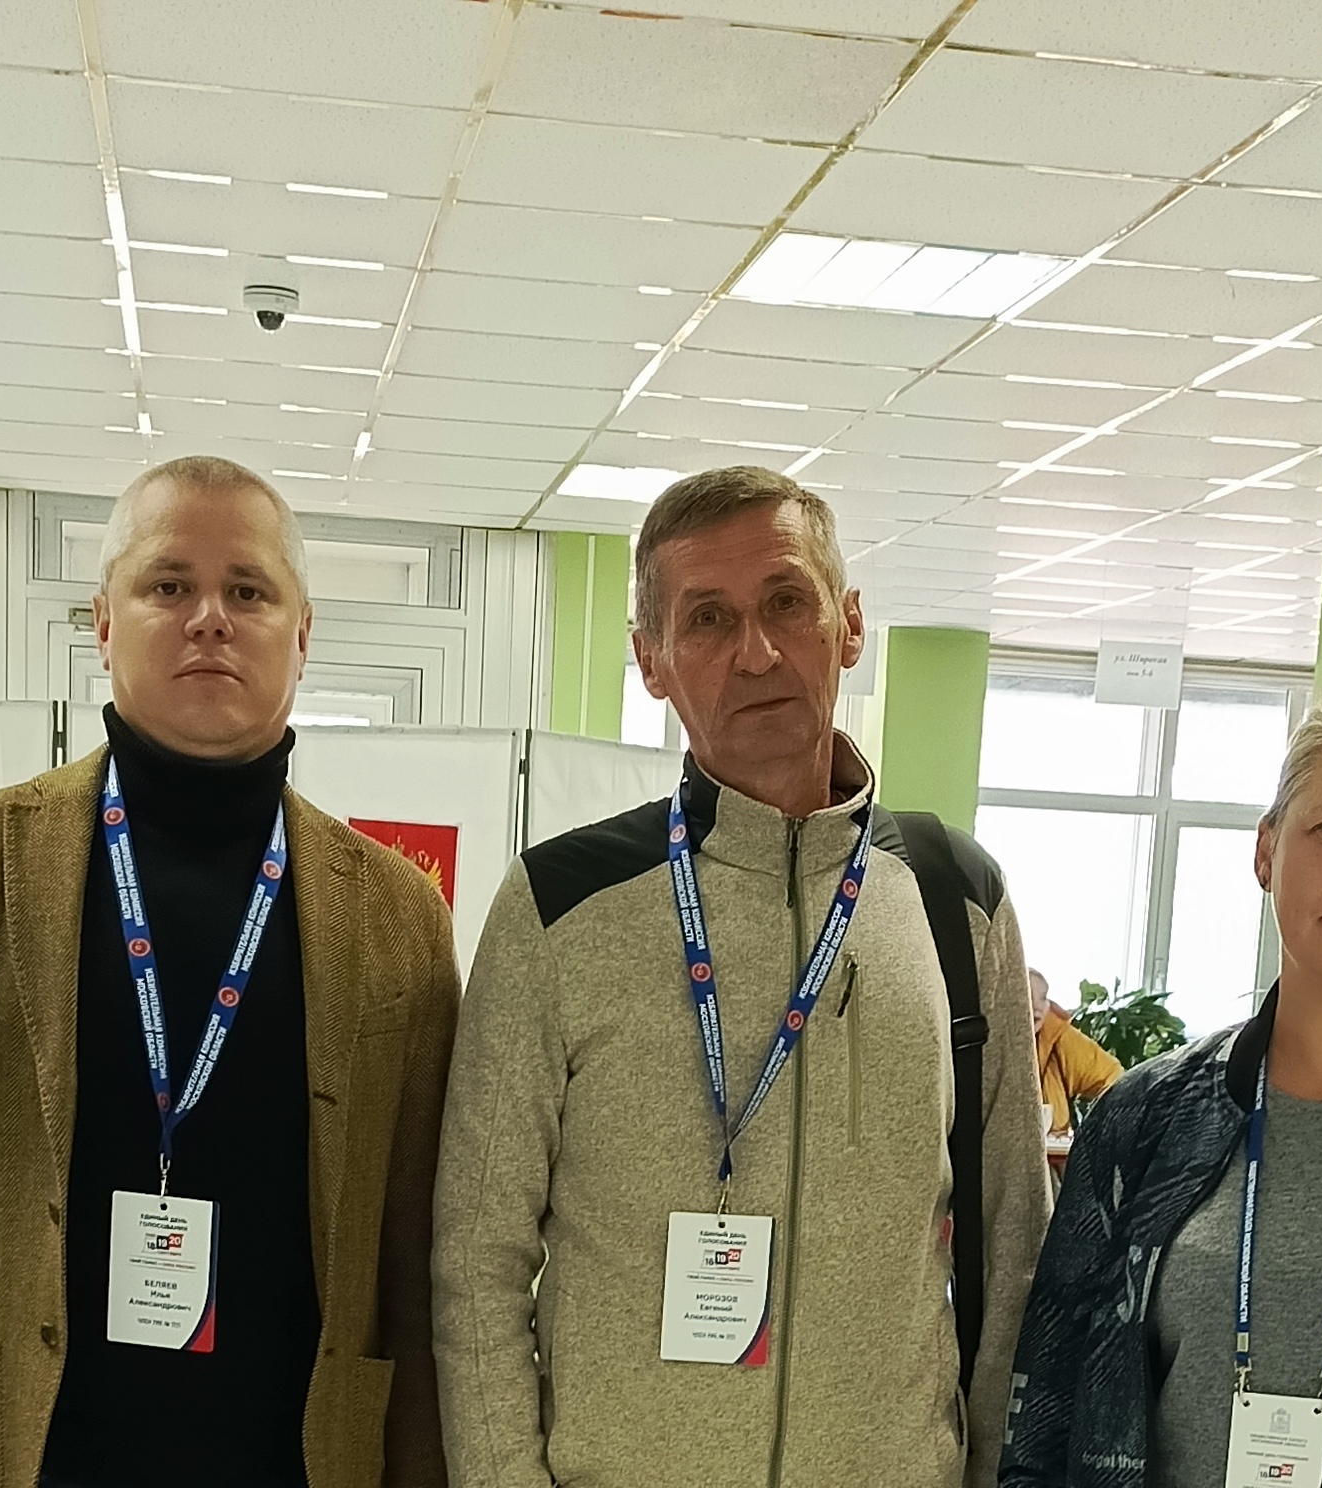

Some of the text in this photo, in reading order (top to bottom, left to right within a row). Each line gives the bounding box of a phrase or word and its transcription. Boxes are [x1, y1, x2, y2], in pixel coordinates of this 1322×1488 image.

[158, 1238, 168, 1248] 19
[169, 1236, 181, 1246] 20
[716, 1253, 727, 1263] 19
[728, 1251, 740, 1261] 20
[1281, 1465, 1292, 1474] 20
